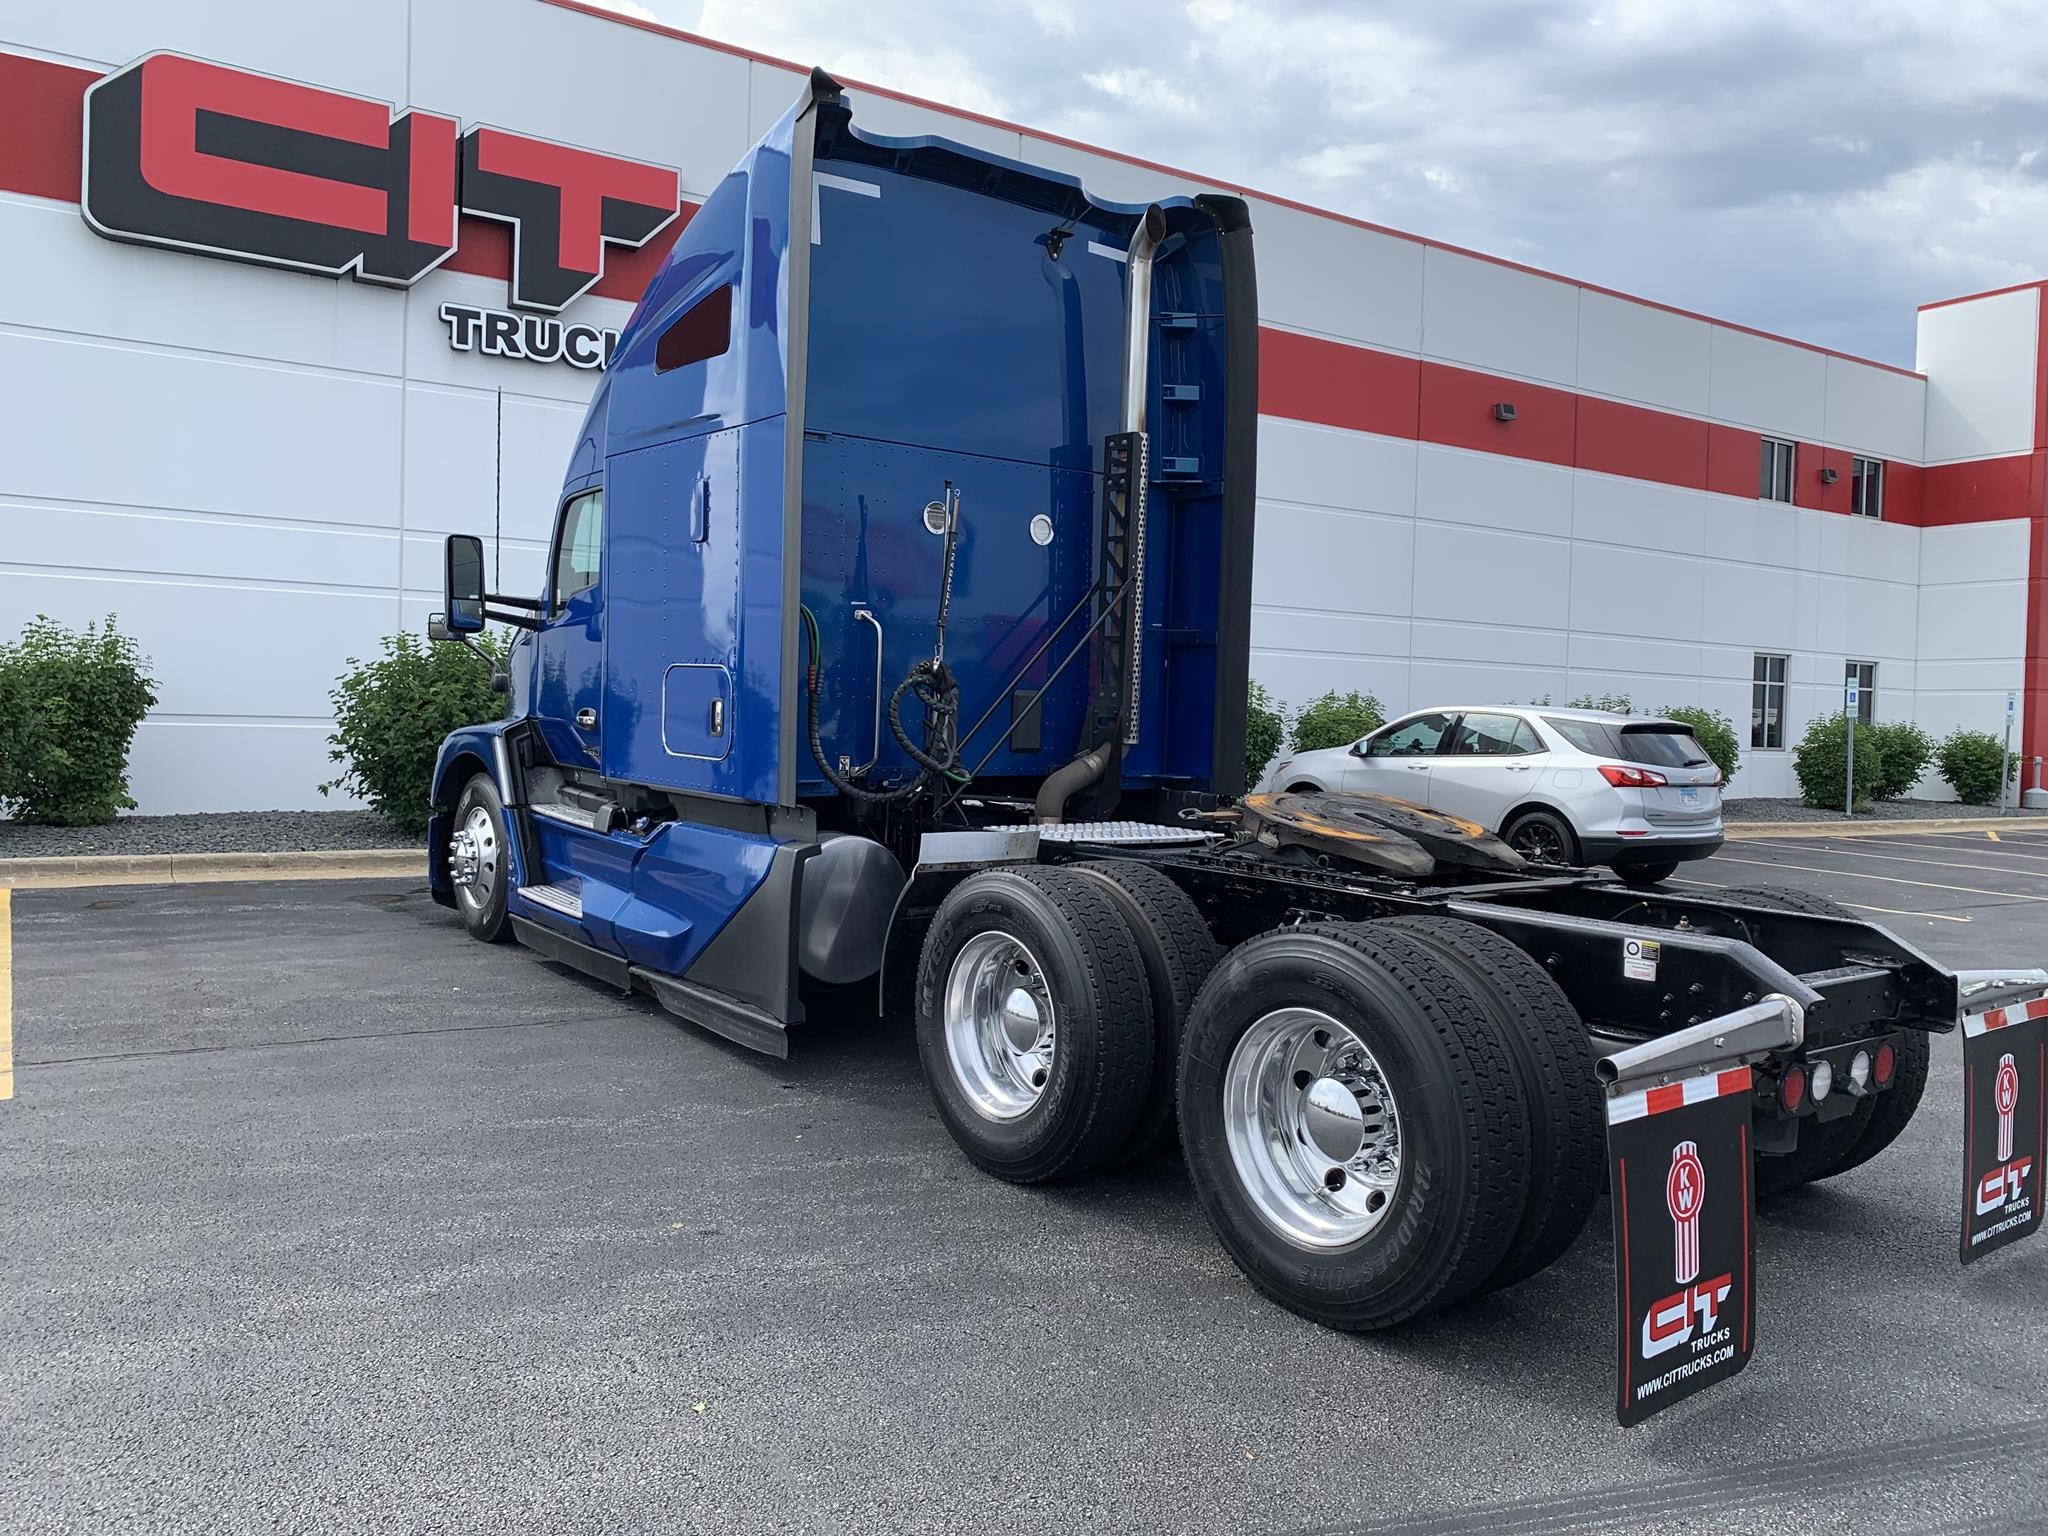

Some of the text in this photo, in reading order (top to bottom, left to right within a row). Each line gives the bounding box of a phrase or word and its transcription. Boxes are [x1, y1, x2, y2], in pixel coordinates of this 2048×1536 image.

[82, 49, 682, 312] CIT
[1976, 1155, 2032, 1216] CIT
[2004, 1196, 2030, 1214] TRUCKS
[1971, 1209, 2032, 1247] WWW.CITTRUCKS.COM
[1642, 1272, 1732, 1360] CIT
[1690, 1326, 1731, 1354] TRUCKS
[1636, 1344, 1735, 1401] WWW.CITTRUCKS.COM
